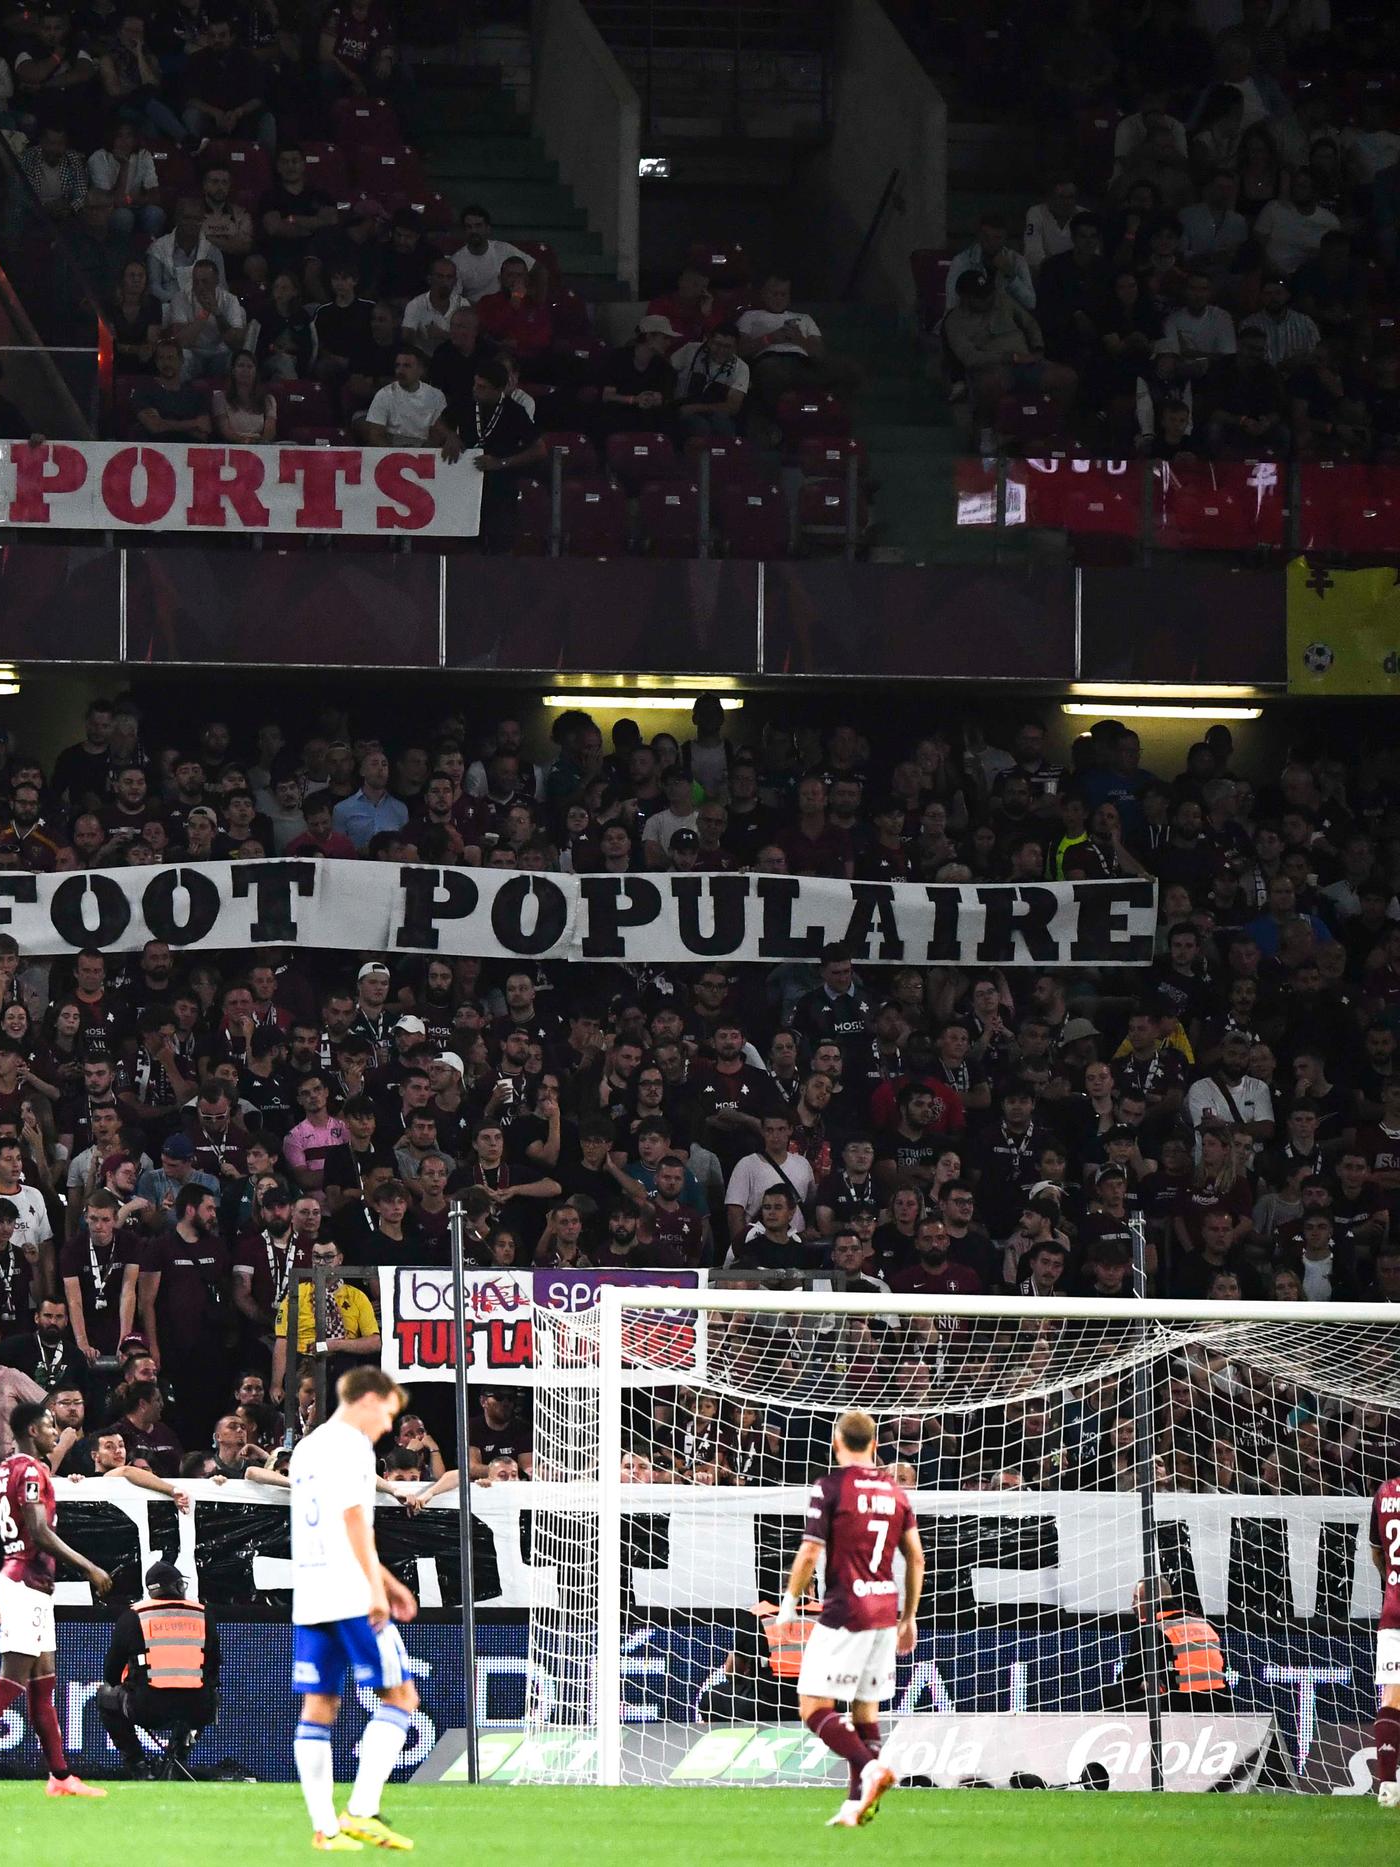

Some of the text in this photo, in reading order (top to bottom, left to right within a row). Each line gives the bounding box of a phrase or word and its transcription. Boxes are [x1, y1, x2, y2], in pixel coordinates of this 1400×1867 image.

[397, 867, 1154, 963] POPULAIRE
[716, 1101, 739, 1110] MOSL
[13, 1222, 30, 1231] OSL
[867, 1519, 890, 1574] 7
[1067, 1722, 1238, 1783] Carola
